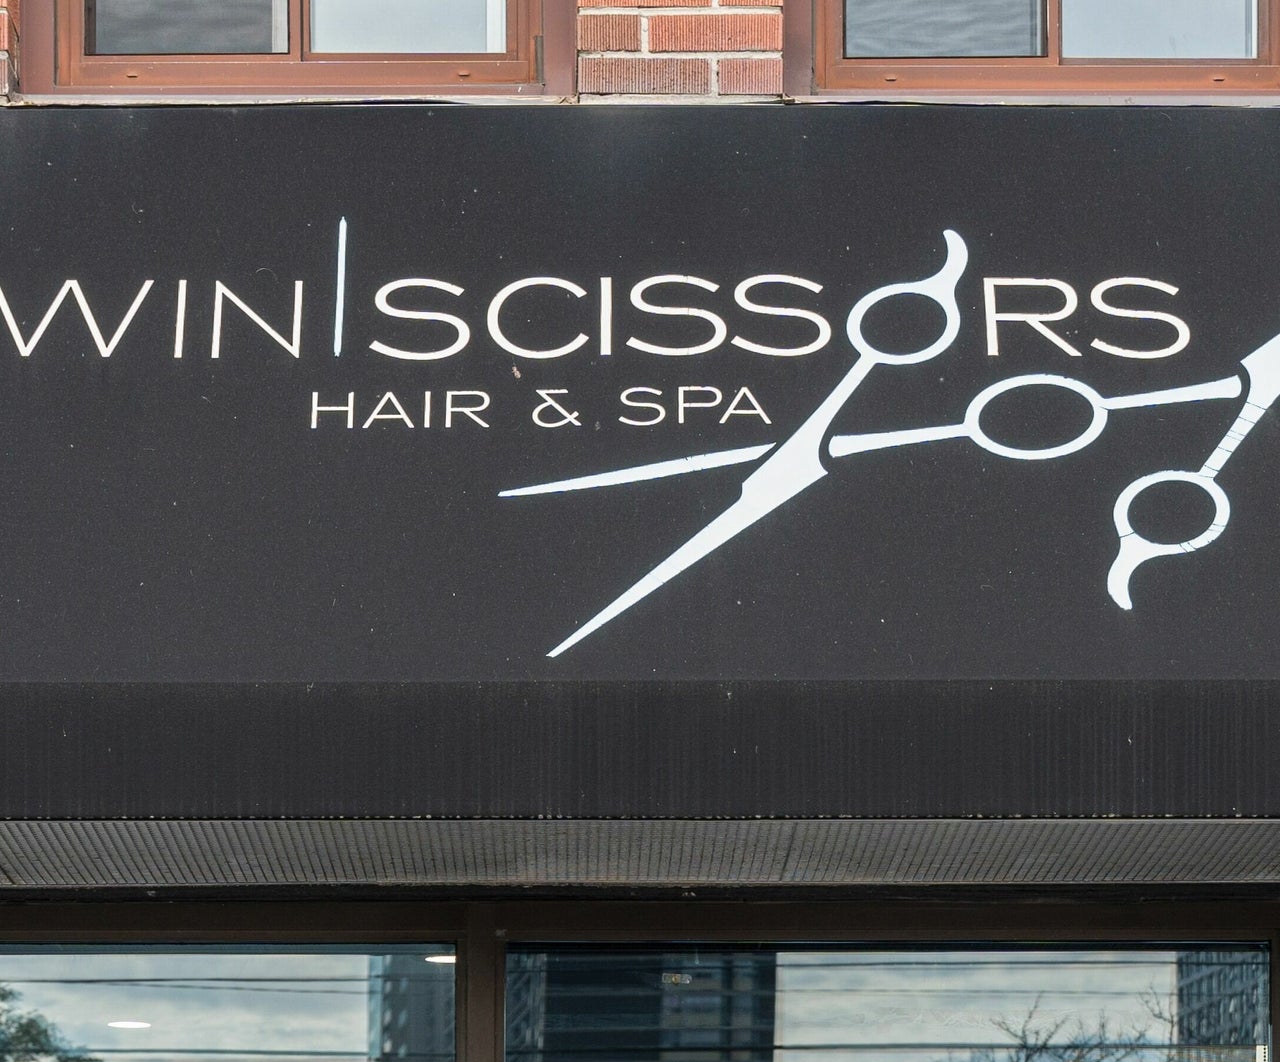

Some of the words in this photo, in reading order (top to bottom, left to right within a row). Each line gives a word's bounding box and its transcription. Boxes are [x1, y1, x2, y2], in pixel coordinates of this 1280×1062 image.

[309, 391, 492, 430] HAIR
[531, 387, 581, 428] &
[618, 385, 773, 427] SPA
